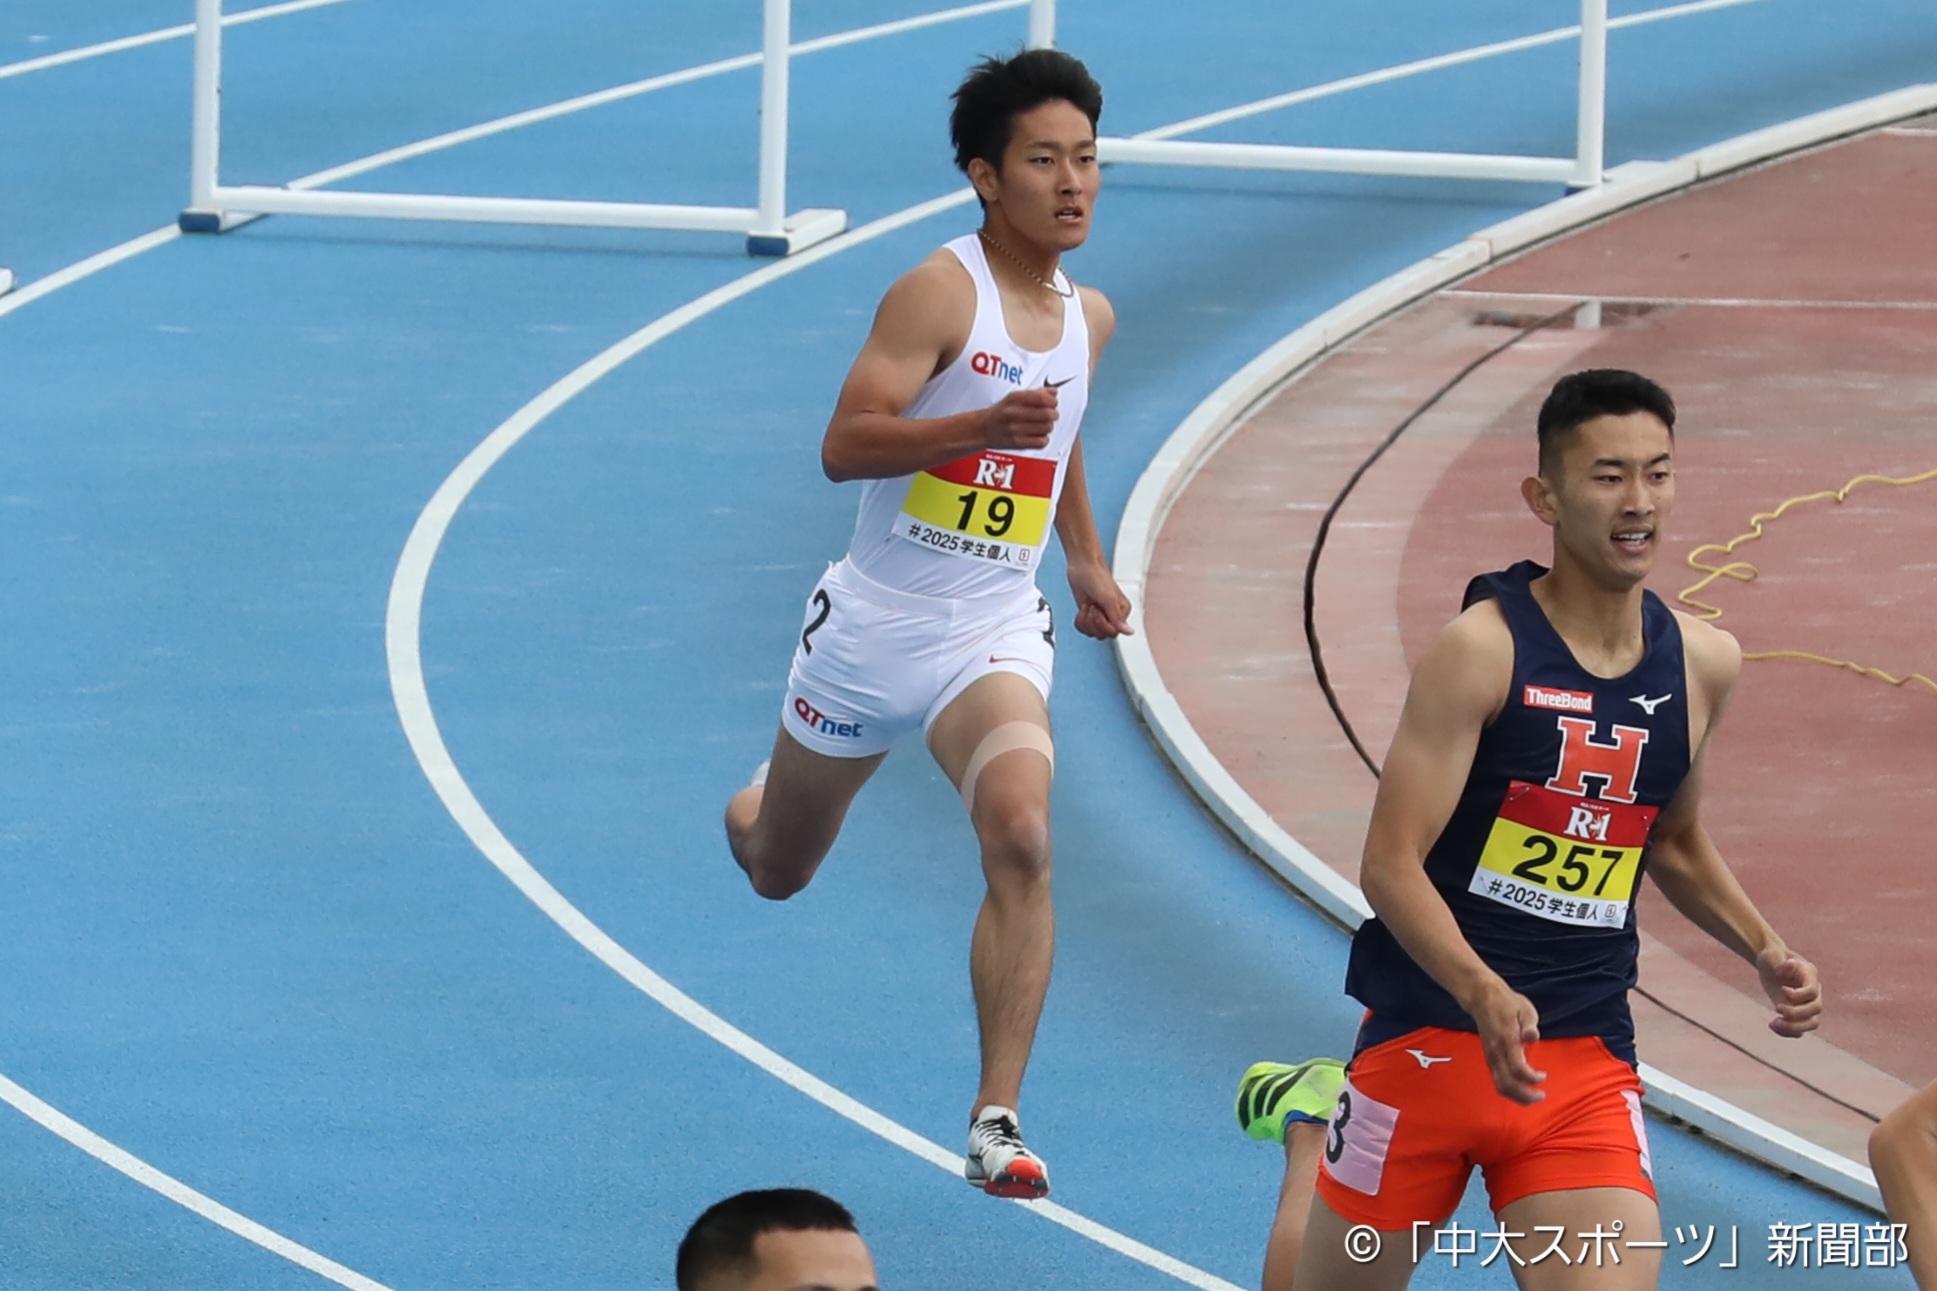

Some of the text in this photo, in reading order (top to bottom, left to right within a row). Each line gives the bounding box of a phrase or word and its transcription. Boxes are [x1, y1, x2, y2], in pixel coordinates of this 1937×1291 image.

[971, 352, 1024, 386] QTnet
[956, 491, 1015, 537] 19
[802, 588, 832, 656] 2
[794, 697, 863, 738] QTnet
[1526, 687, 1593, 712] ThreeBond
[1545, 715, 1650, 804] H
[1511, 835, 1624, 896] 257
[1326, 1091, 1351, 1164] 3
